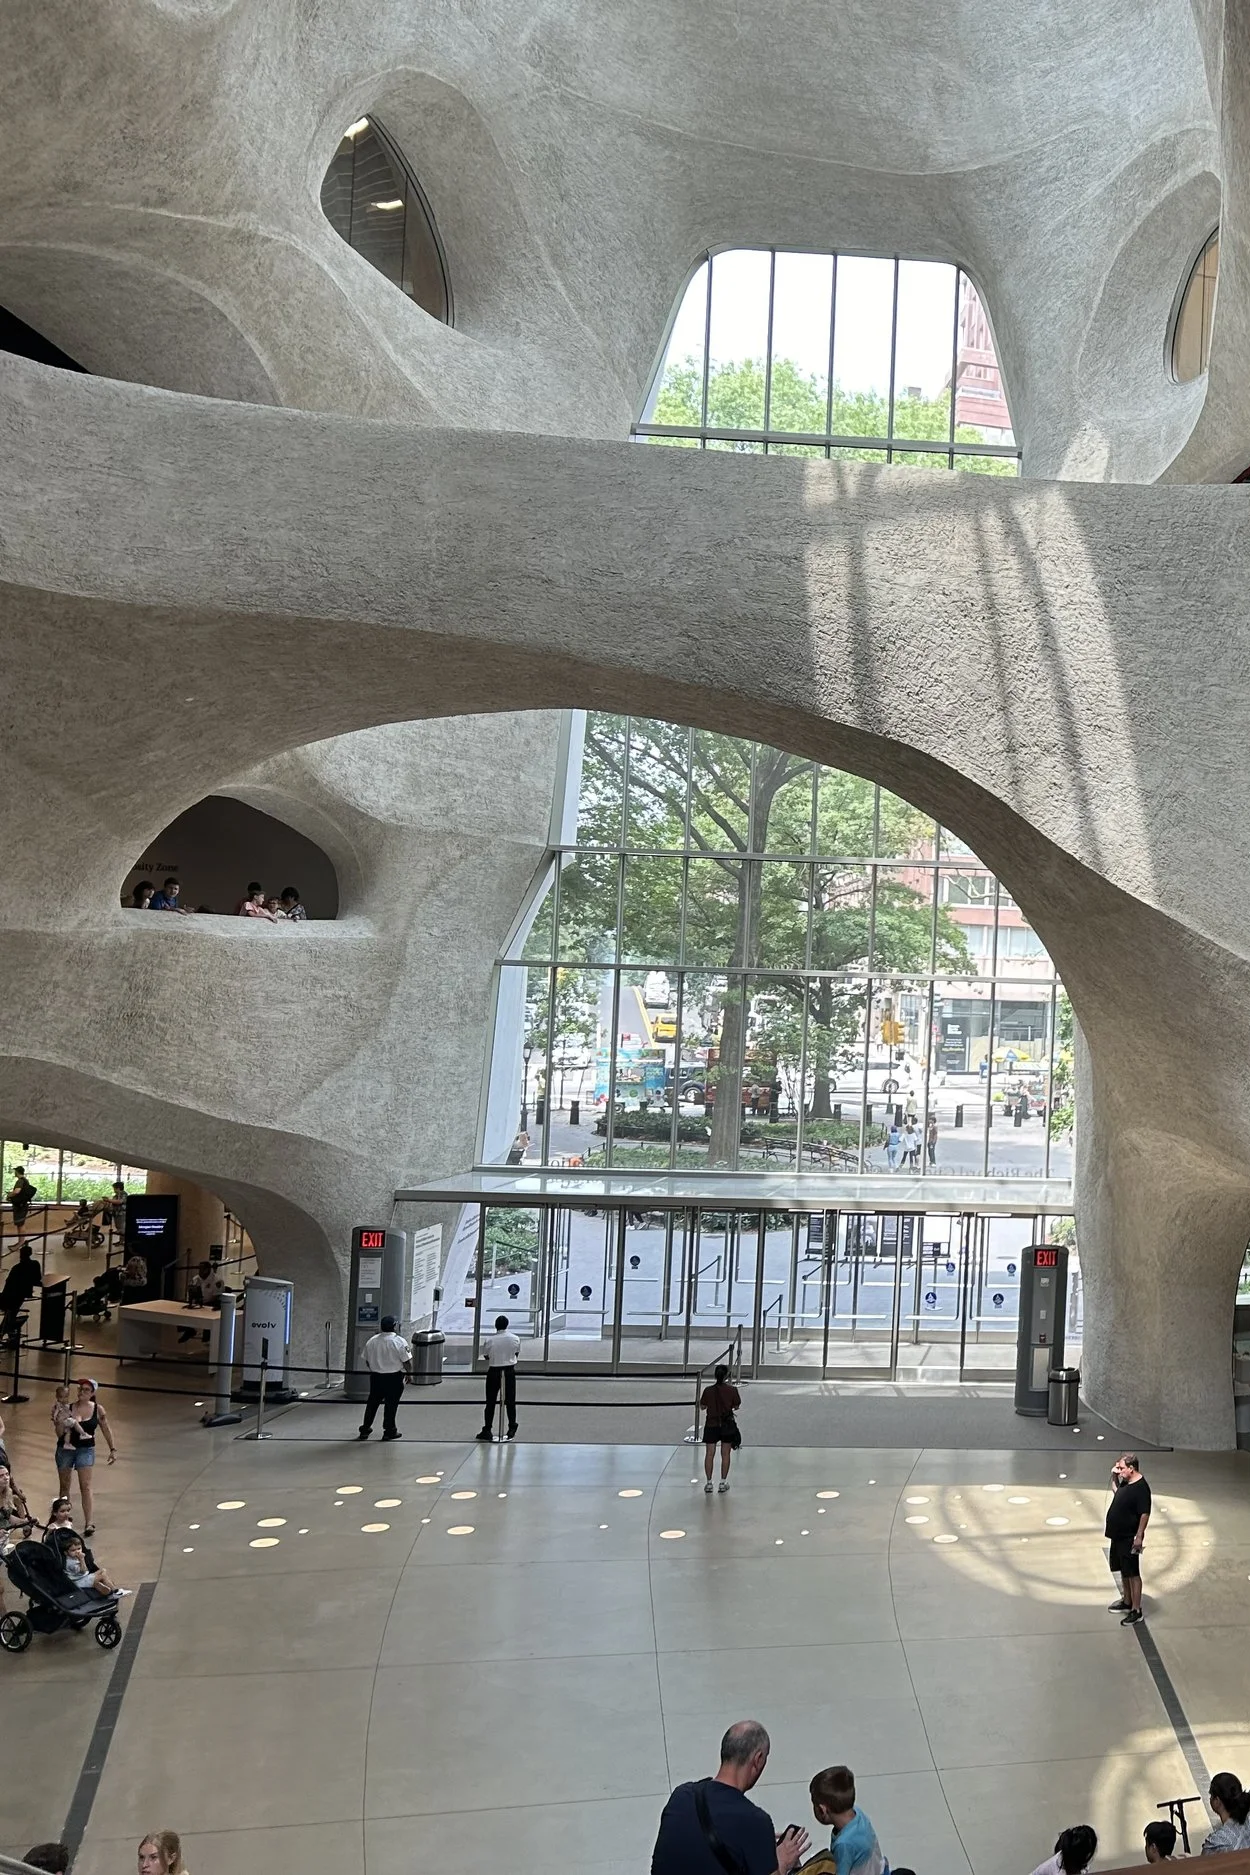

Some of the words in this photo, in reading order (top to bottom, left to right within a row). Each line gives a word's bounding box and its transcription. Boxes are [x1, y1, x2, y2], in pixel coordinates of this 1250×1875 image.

[362, 1232, 384, 1247] EXIT
[1037, 1250, 1058, 1266] EXIT
[251, 1321, 278, 1329] evolv
